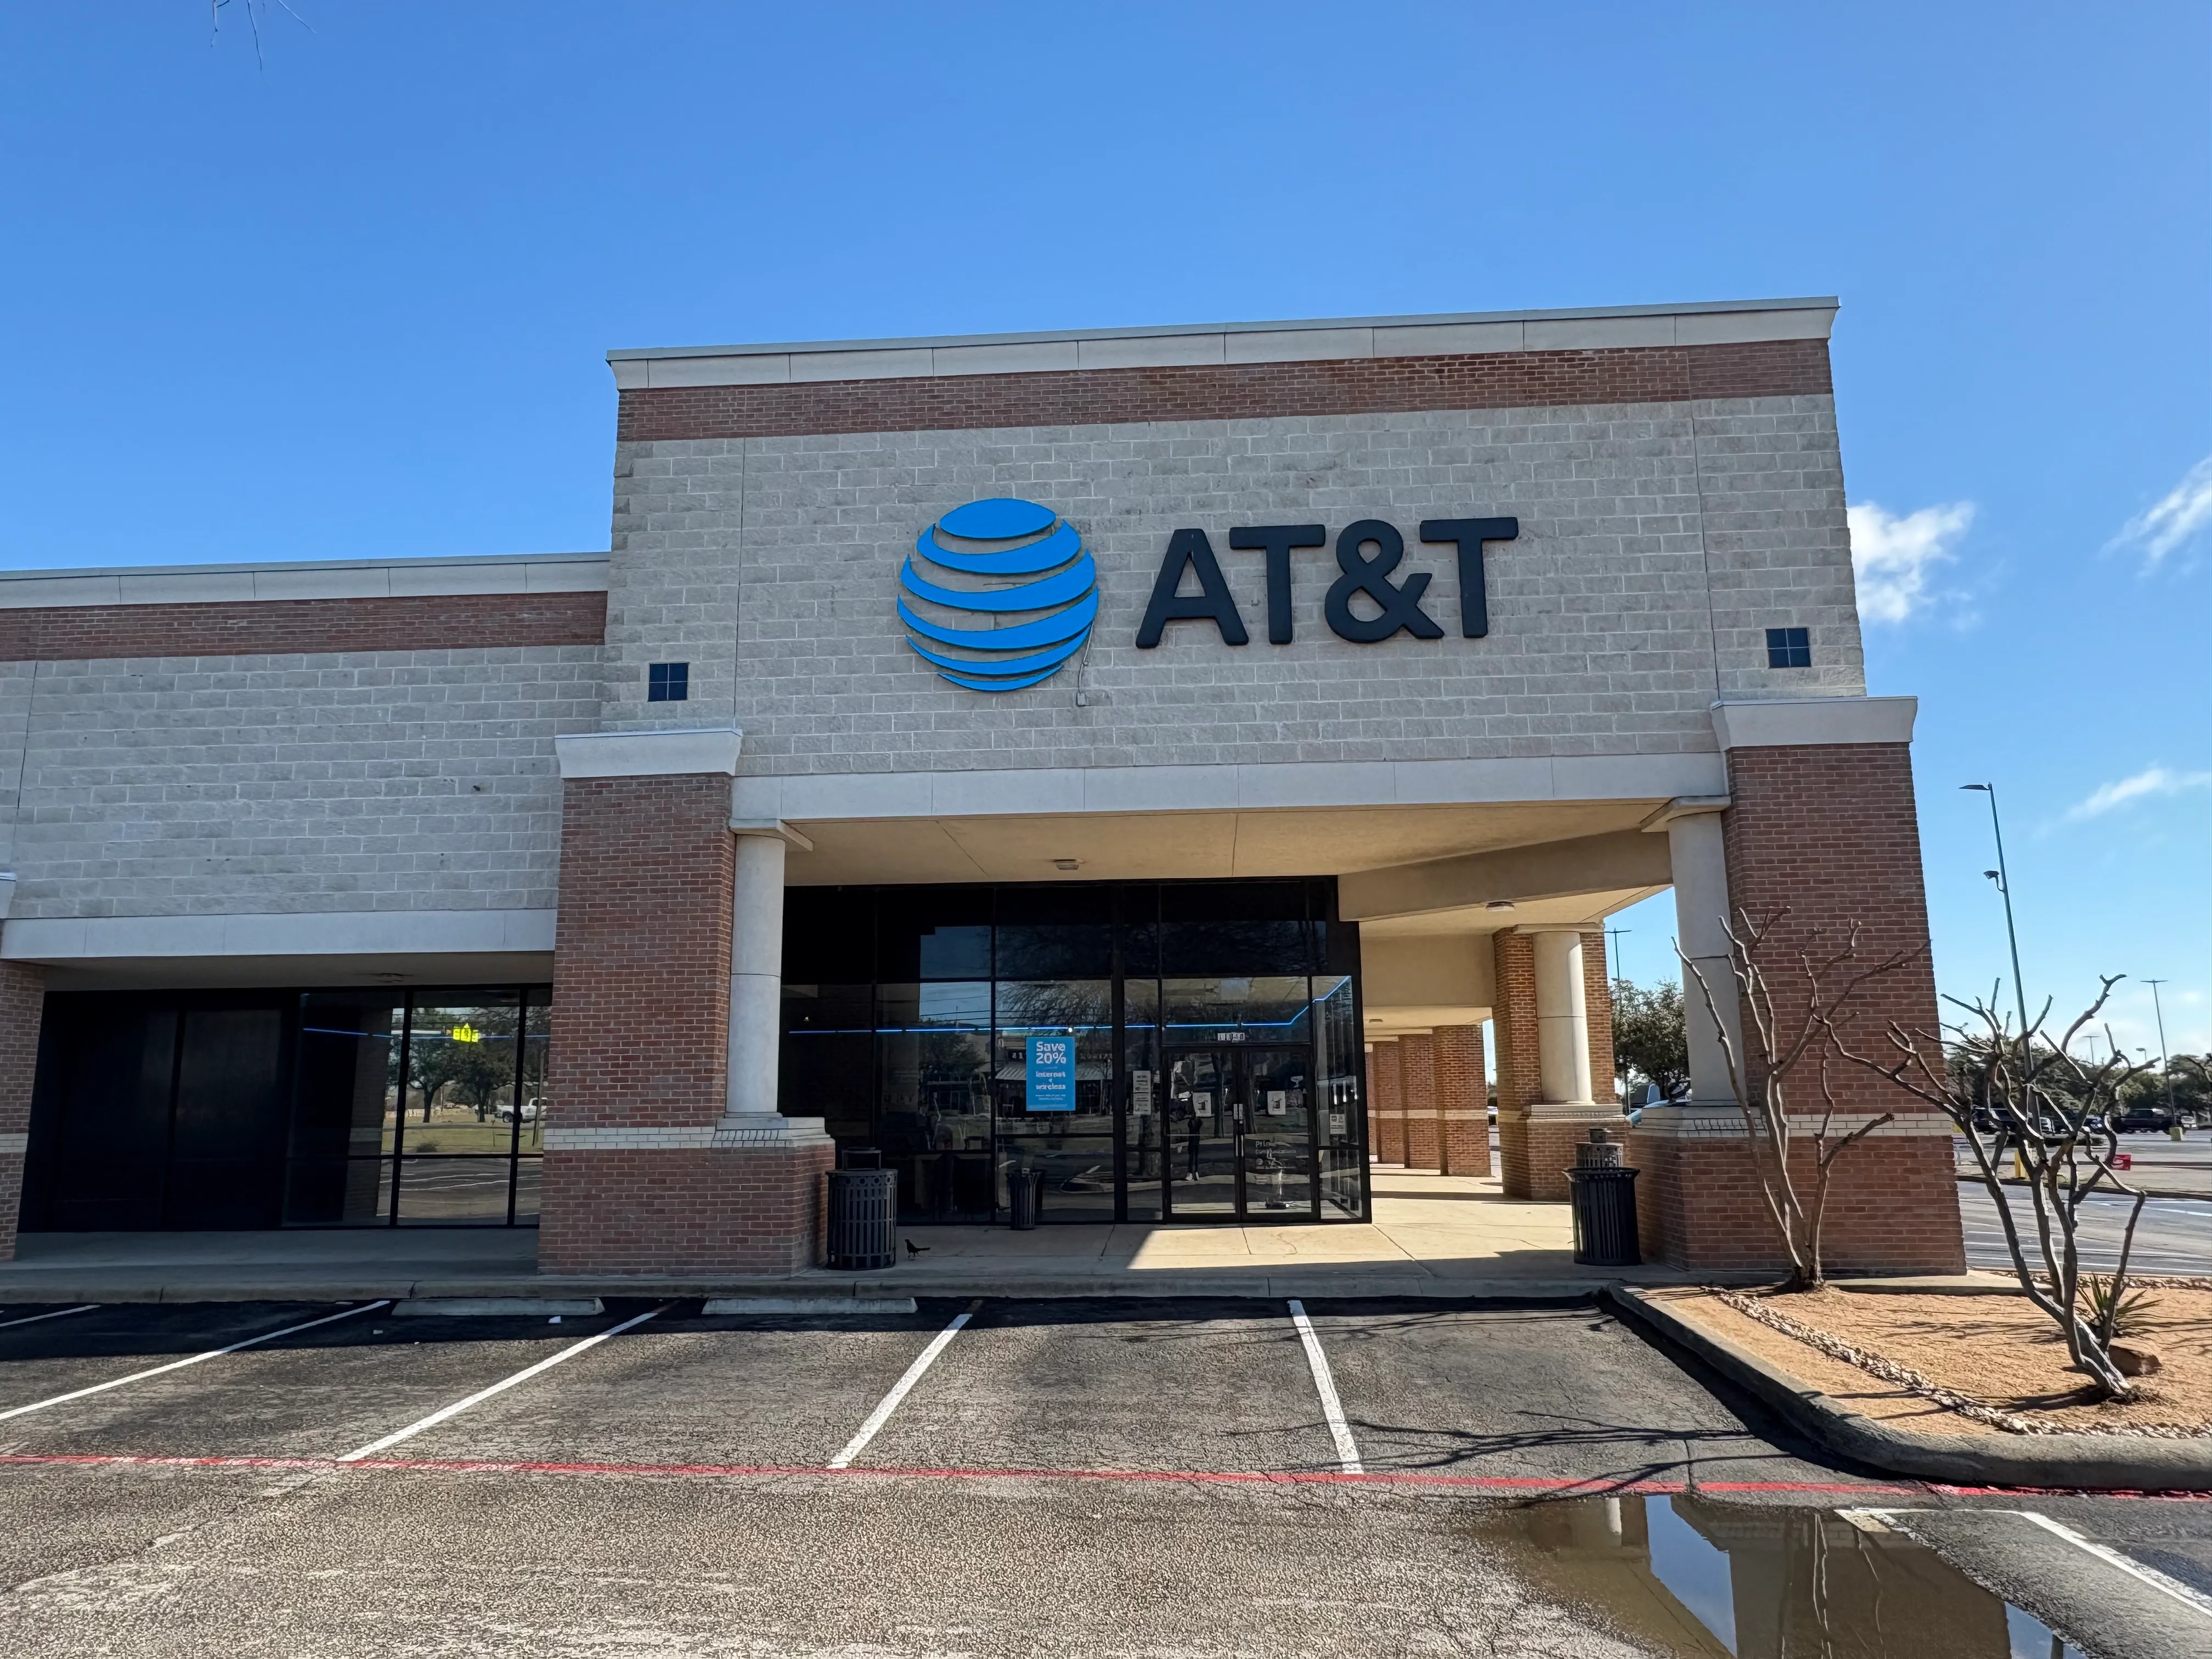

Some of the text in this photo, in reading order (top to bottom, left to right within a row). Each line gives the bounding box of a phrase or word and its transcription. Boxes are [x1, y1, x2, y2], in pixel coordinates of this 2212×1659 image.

[1136, 517, 1518, 650] AT&T
[1036, 1041, 1065, 1052] Save
[1036, 1052, 1066, 1064] 20%
